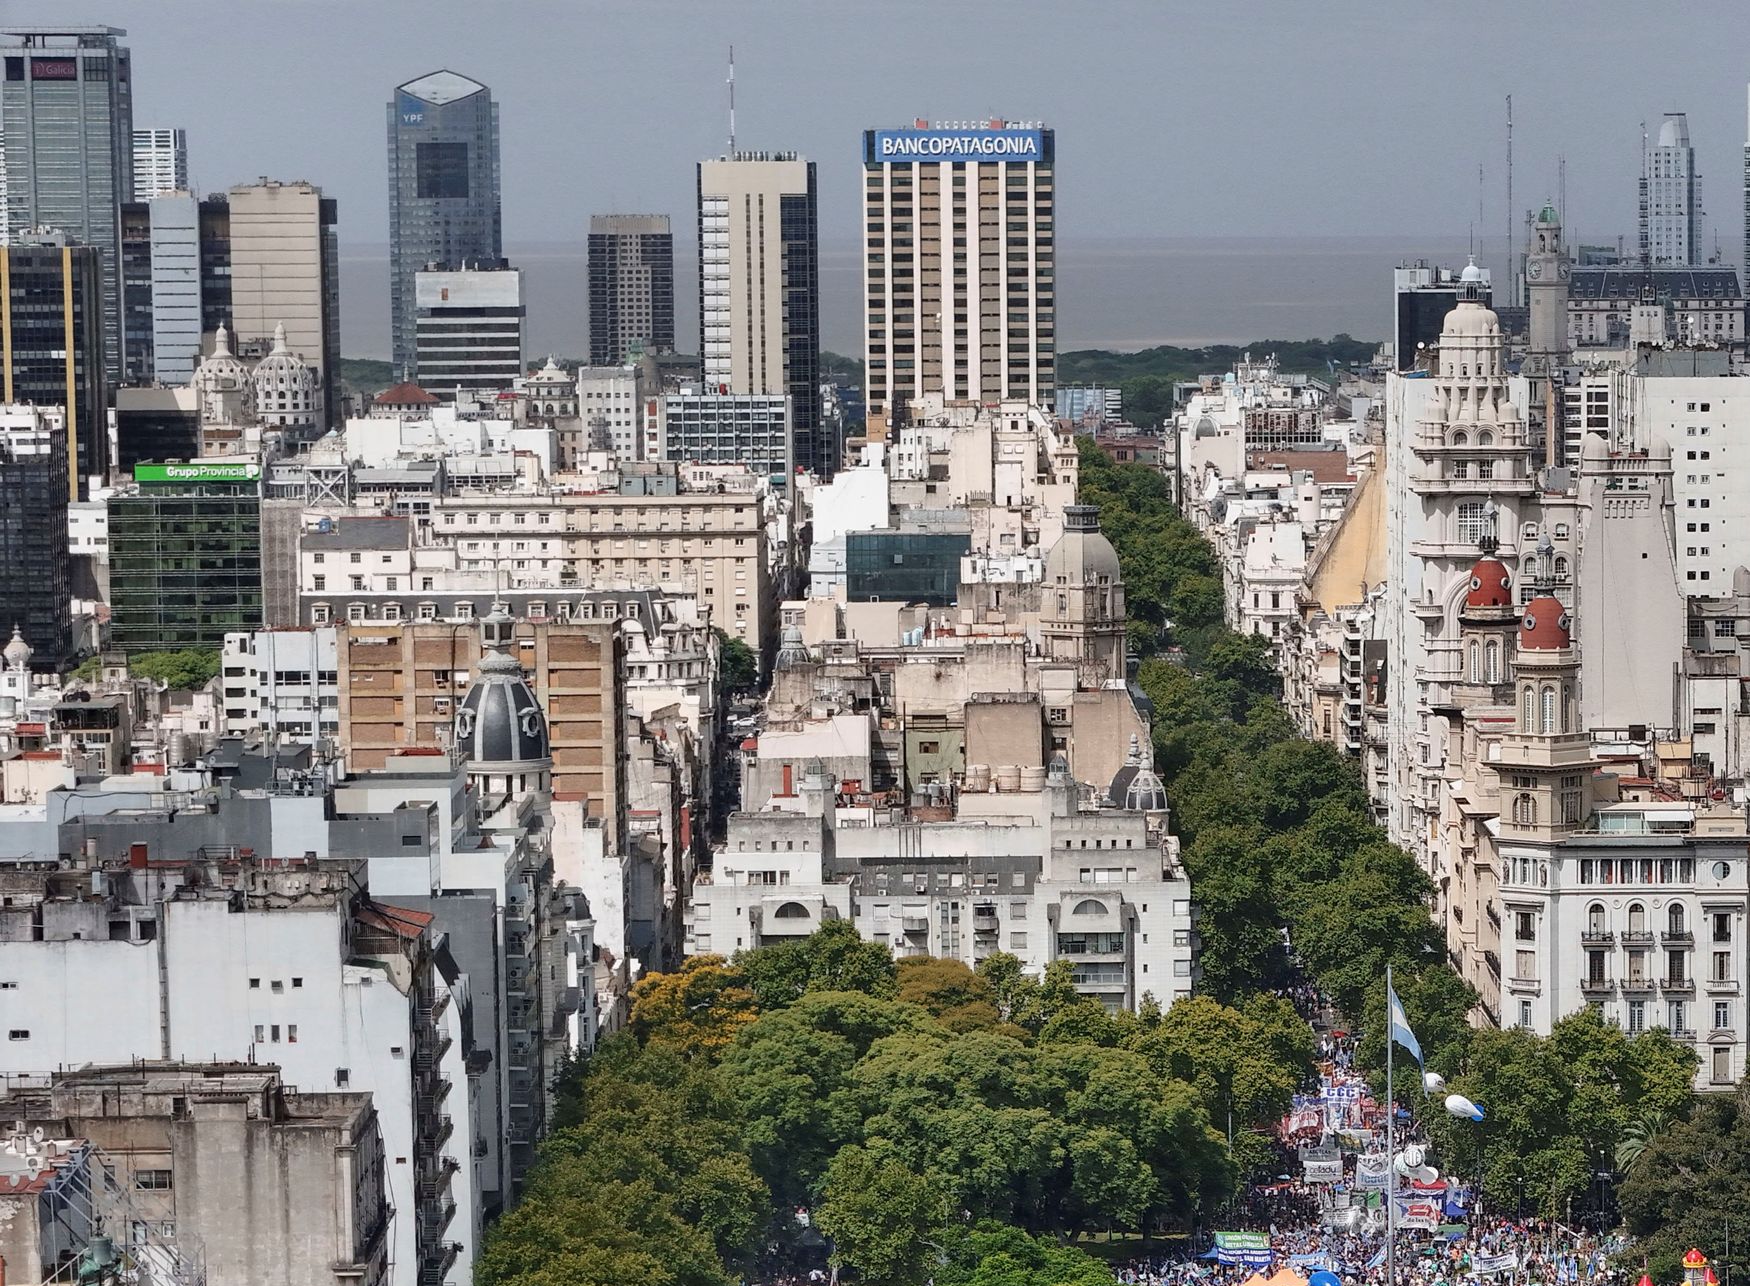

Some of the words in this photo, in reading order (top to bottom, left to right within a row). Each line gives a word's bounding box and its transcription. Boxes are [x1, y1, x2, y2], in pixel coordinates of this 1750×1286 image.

[49, 62, 76, 75] Galicia
[403, 114, 423, 123] YPF
[882, 137, 1037, 155] BANCOPATAGONIA
[167, 466, 199, 478] Grupo
[199, 466, 245, 477] Provincia
[1326, 1087, 1356, 1098] CCC
